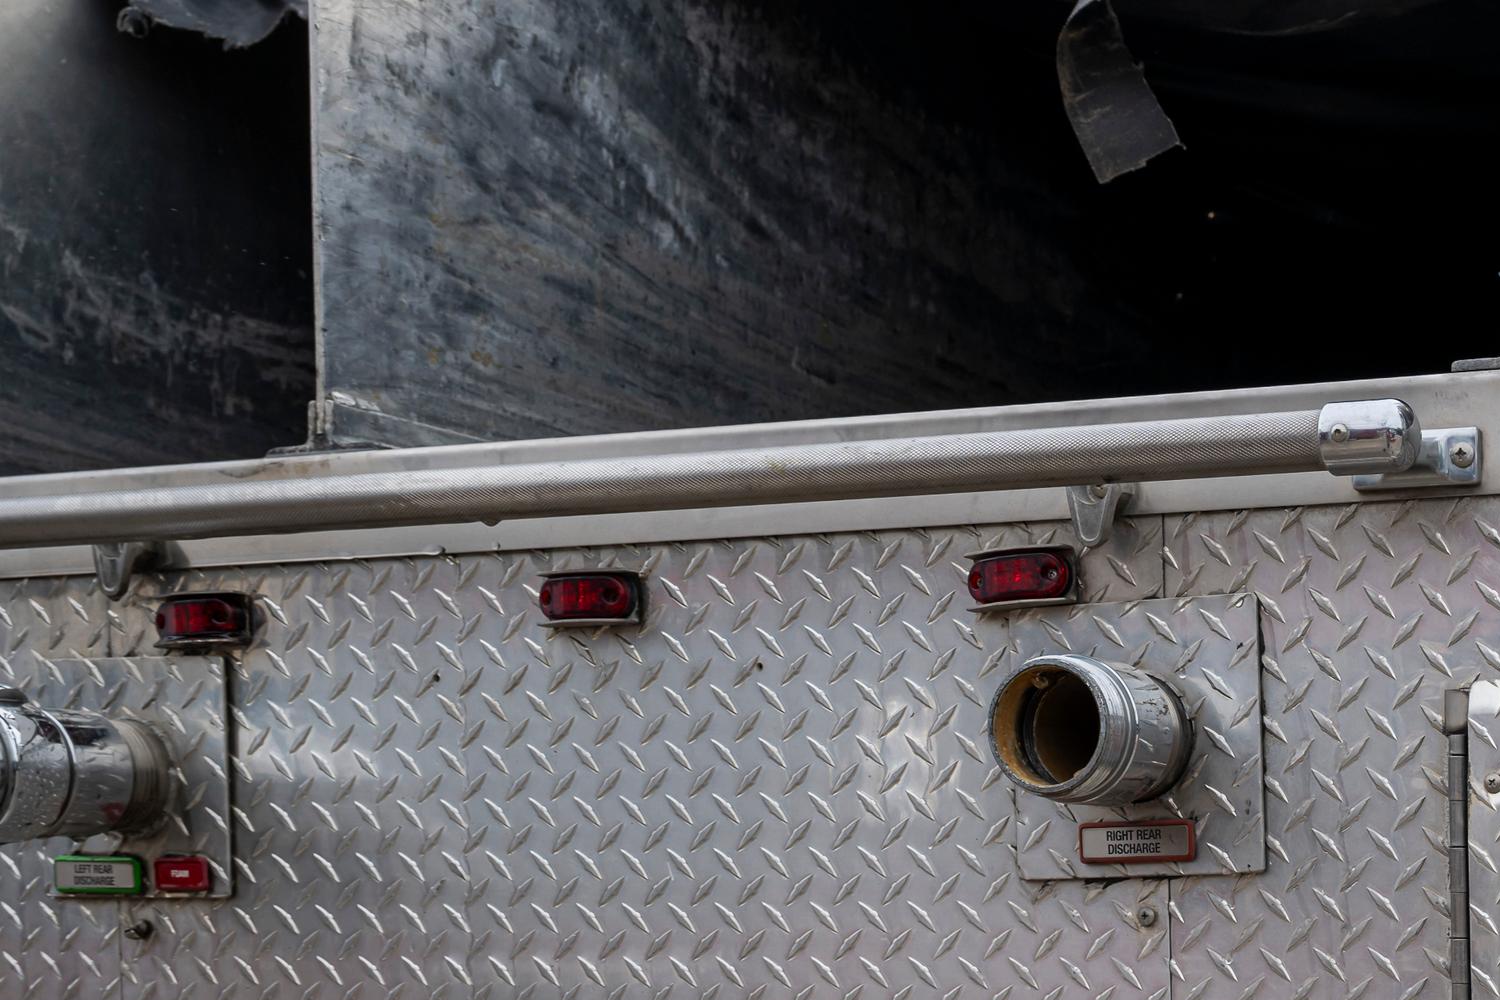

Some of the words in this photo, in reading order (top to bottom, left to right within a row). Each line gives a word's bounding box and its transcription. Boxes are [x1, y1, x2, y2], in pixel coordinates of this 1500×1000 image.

[1106, 830, 1135, 842] RIGHT
[1136, 829, 1161, 840] REAR
[1107, 842, 1161, 855] DISCHARGE
[74, 864, 91, 874] LEFT
[93, 864, 113, 874] REAR
[73, 876, 115, 886] DISCHARGE
